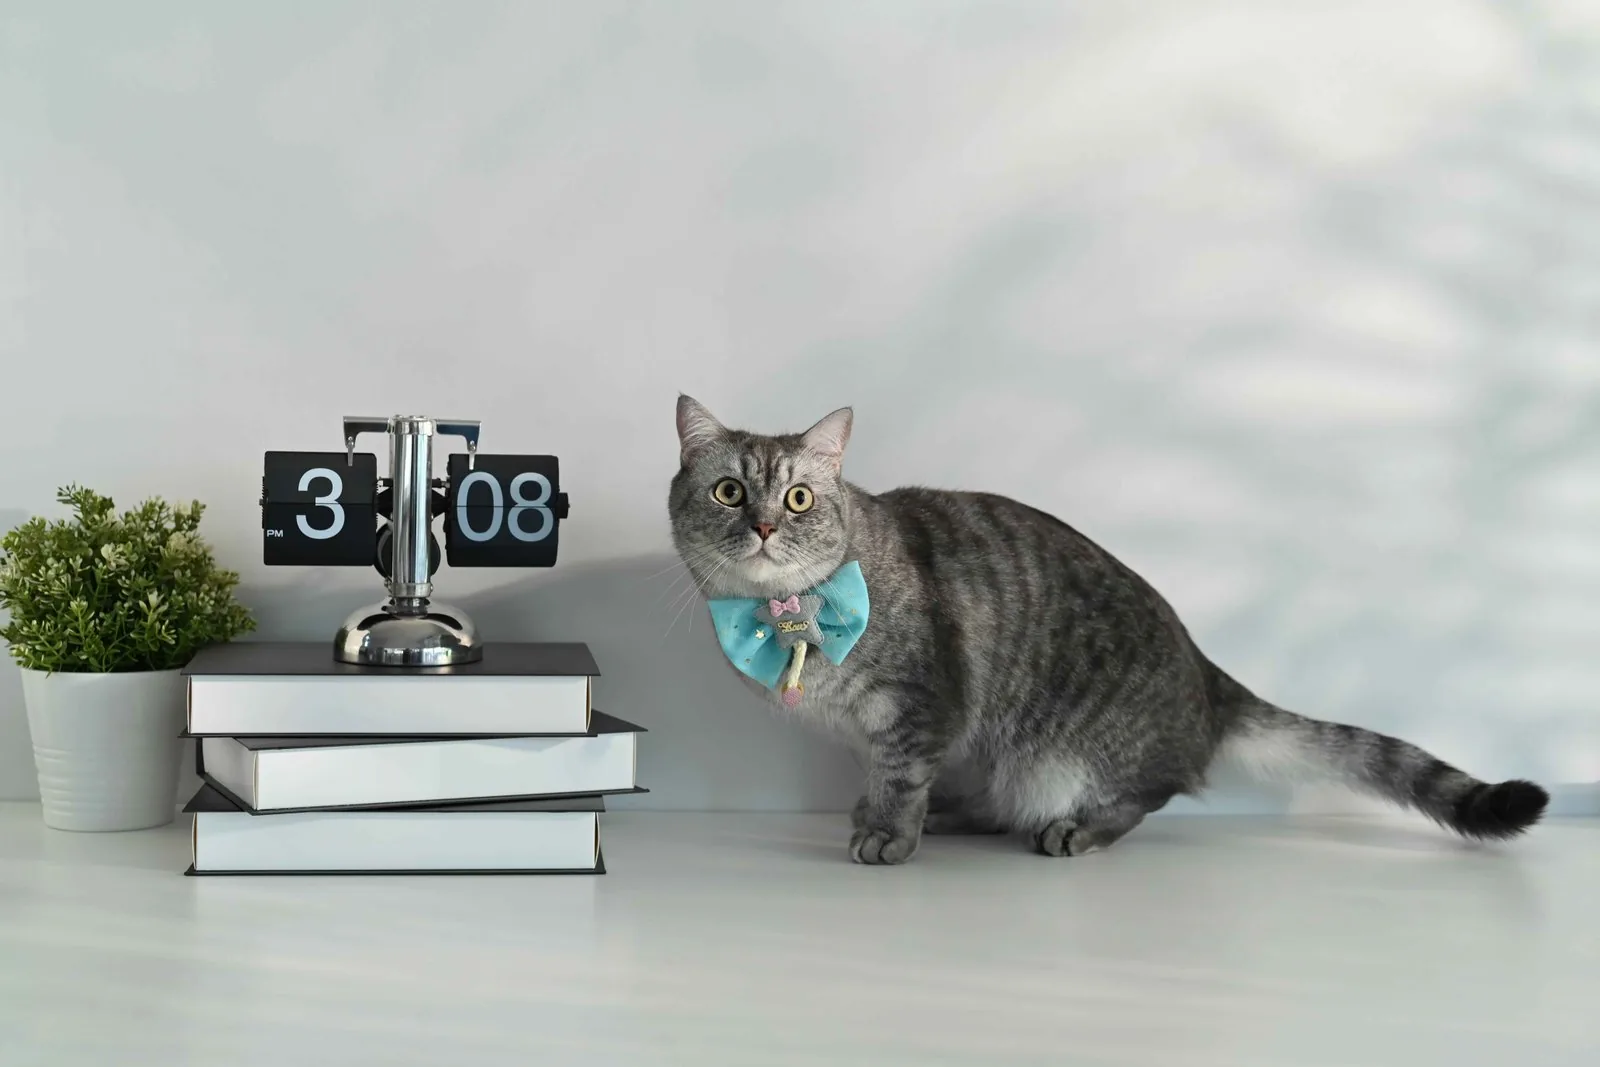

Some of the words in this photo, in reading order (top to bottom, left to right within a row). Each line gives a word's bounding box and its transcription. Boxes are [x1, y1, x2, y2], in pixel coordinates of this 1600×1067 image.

[266, 529, 284, 538] PM
[295, 467, 346, 540] 3
[456, 471, 554, 542] 08
